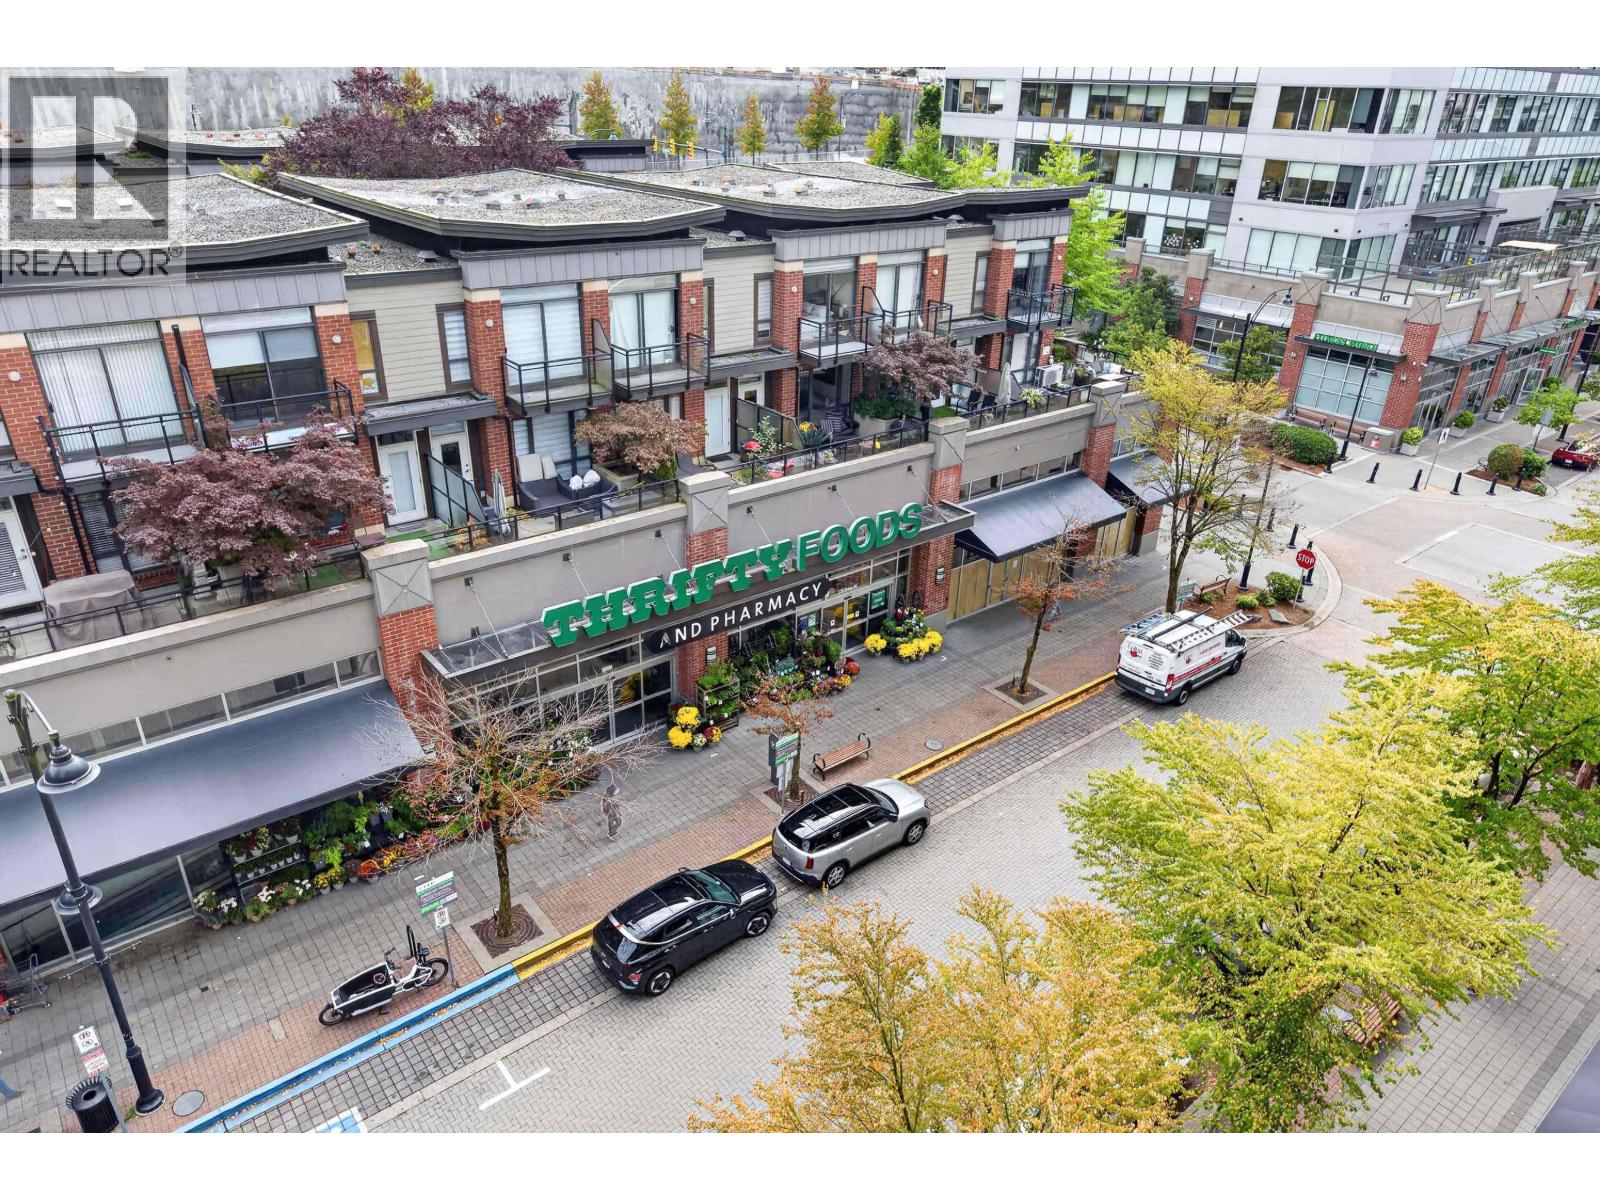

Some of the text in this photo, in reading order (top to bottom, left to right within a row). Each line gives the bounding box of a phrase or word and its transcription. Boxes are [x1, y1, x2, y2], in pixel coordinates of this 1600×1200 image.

[541, 502, 923, 648] THRIFTY FOODS
[1297, 553, 1315, 565] STOP
[659, 621, 701, 649] AND
[710, 582, 823, 632] PHARMACY
